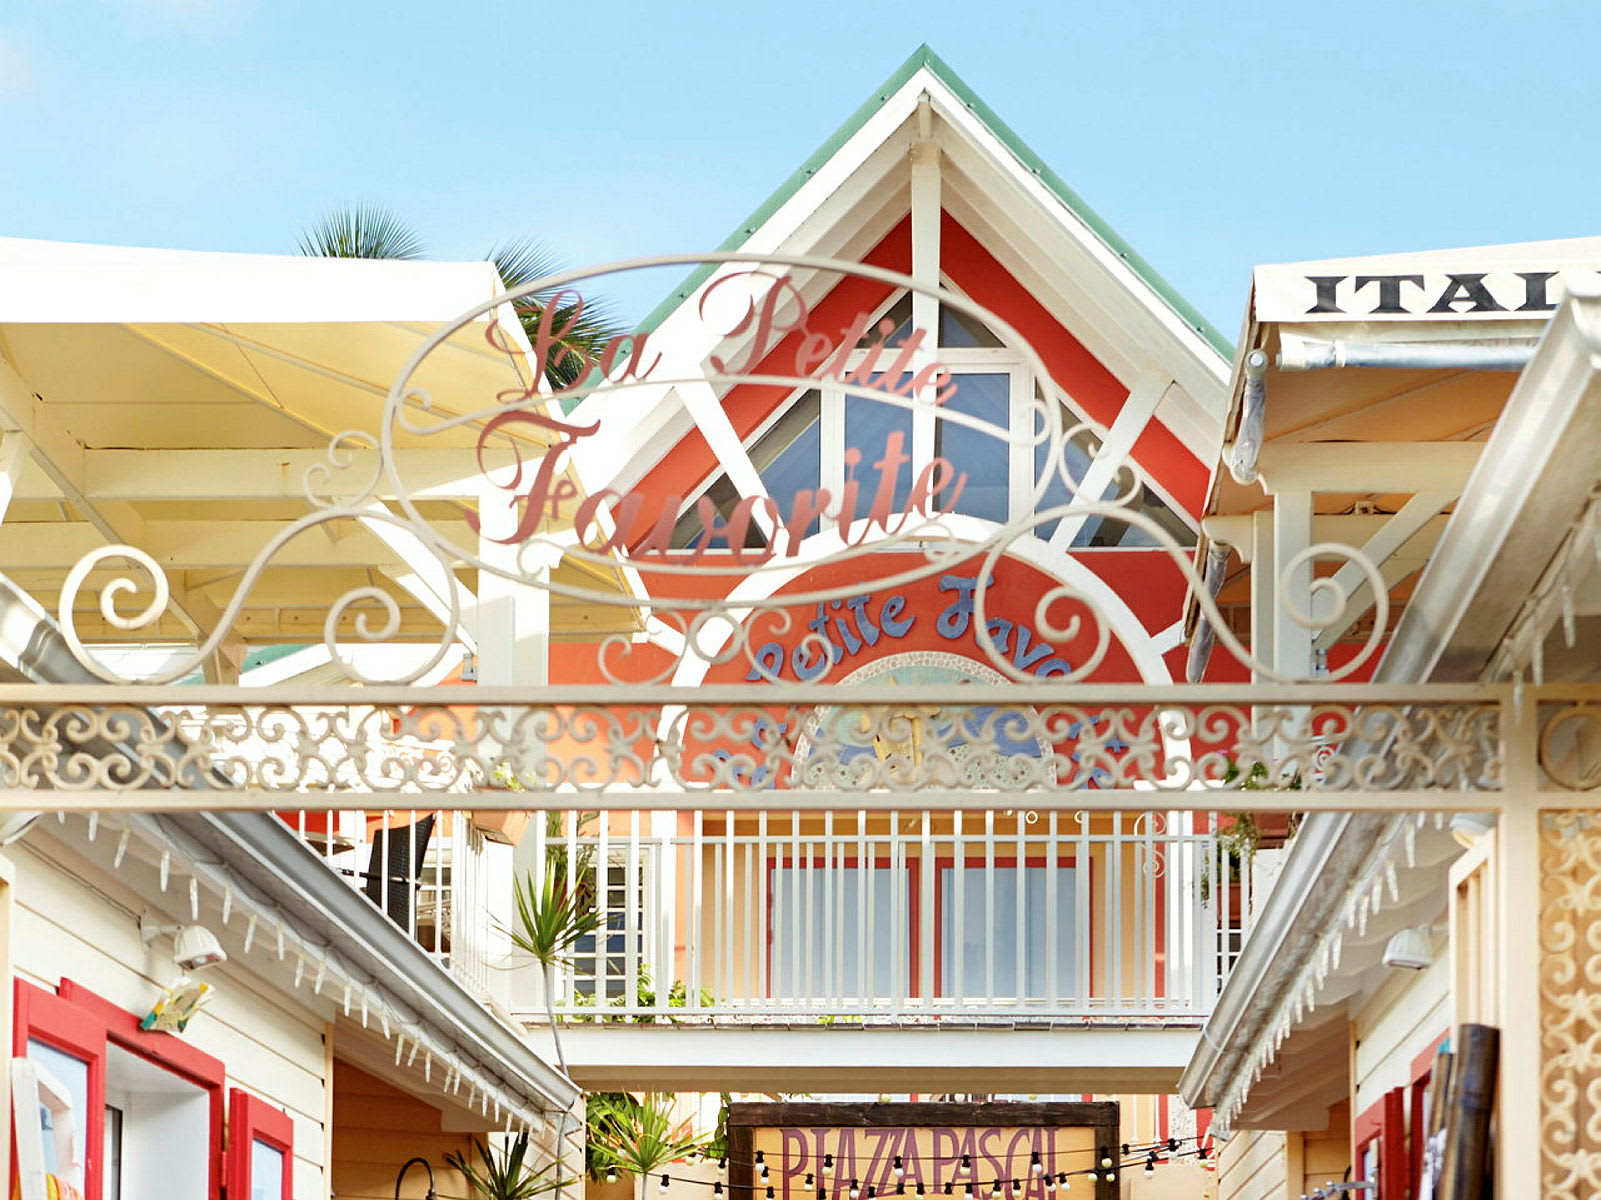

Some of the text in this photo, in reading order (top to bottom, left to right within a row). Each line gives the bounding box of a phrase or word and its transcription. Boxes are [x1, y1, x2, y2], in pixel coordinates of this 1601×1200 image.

[485, 271, 958, 406] La Petite
[1303, 270, 1601, 314] ITAL
[464, 410, 968, 566] Favorite
